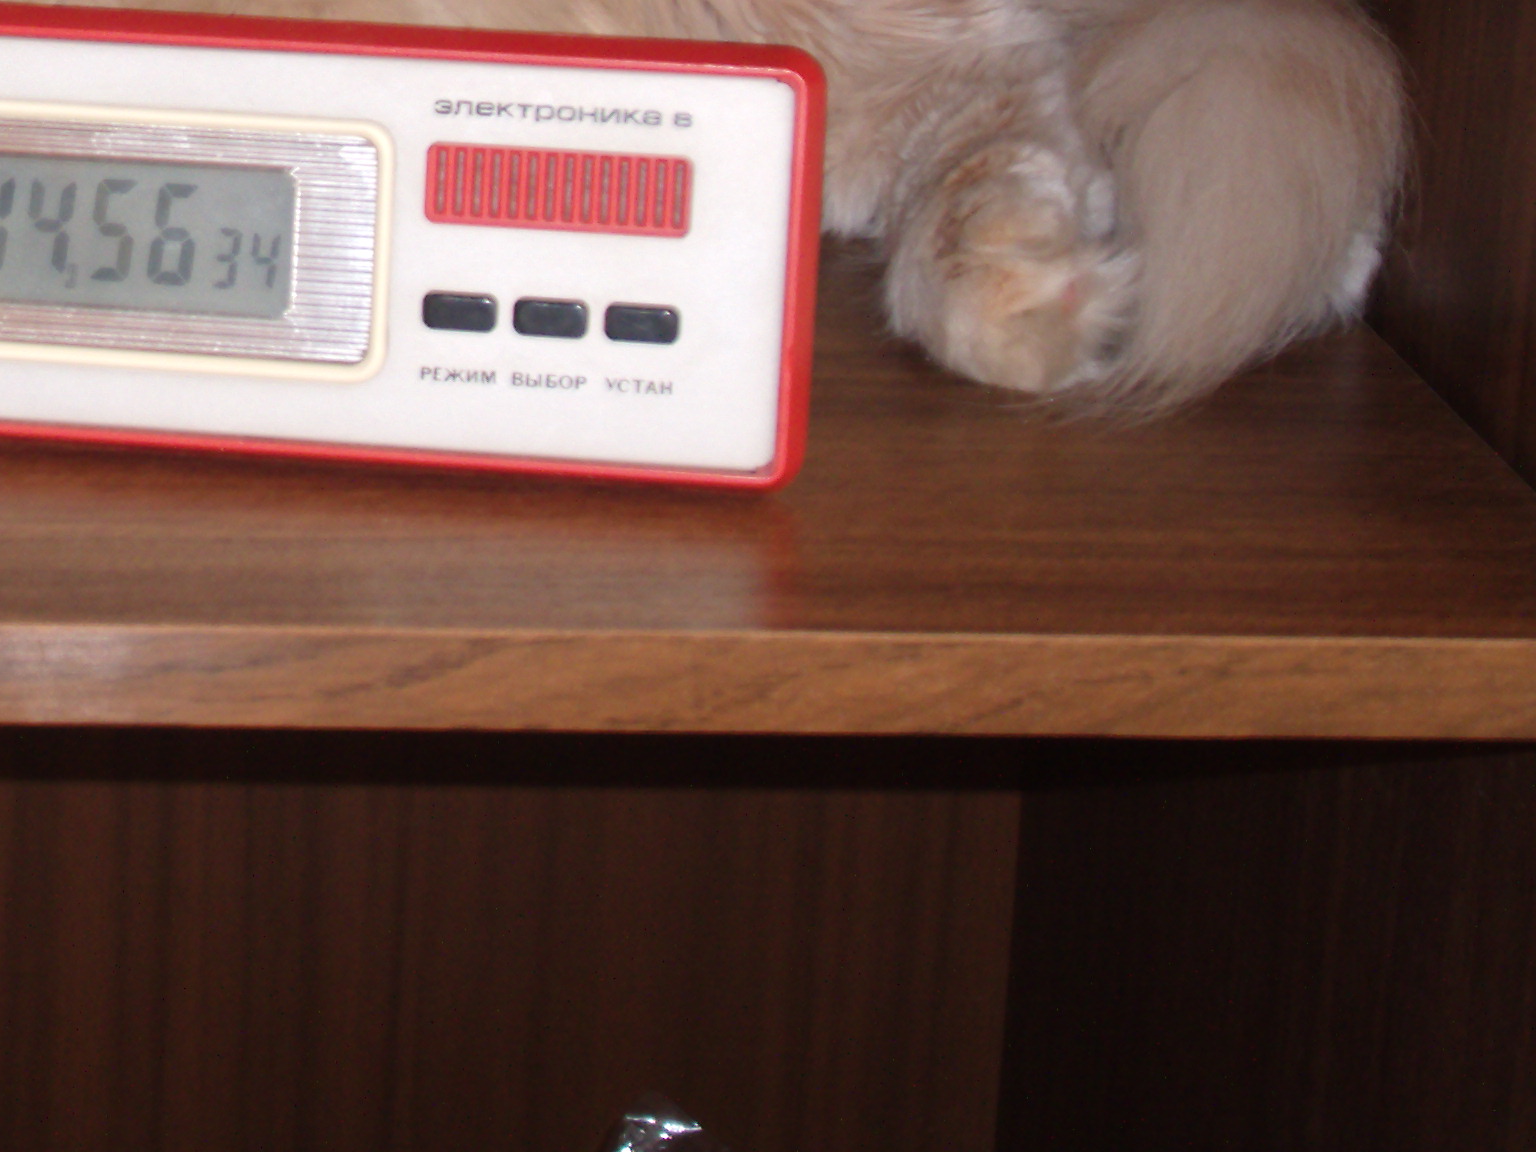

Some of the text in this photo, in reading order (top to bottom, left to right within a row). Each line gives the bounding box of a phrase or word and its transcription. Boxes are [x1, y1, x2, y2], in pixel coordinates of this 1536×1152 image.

[213, 227, 282, 289] 34
[418, 365, 674, 396] РЕЖИМ ВЫБОР УСТАН
